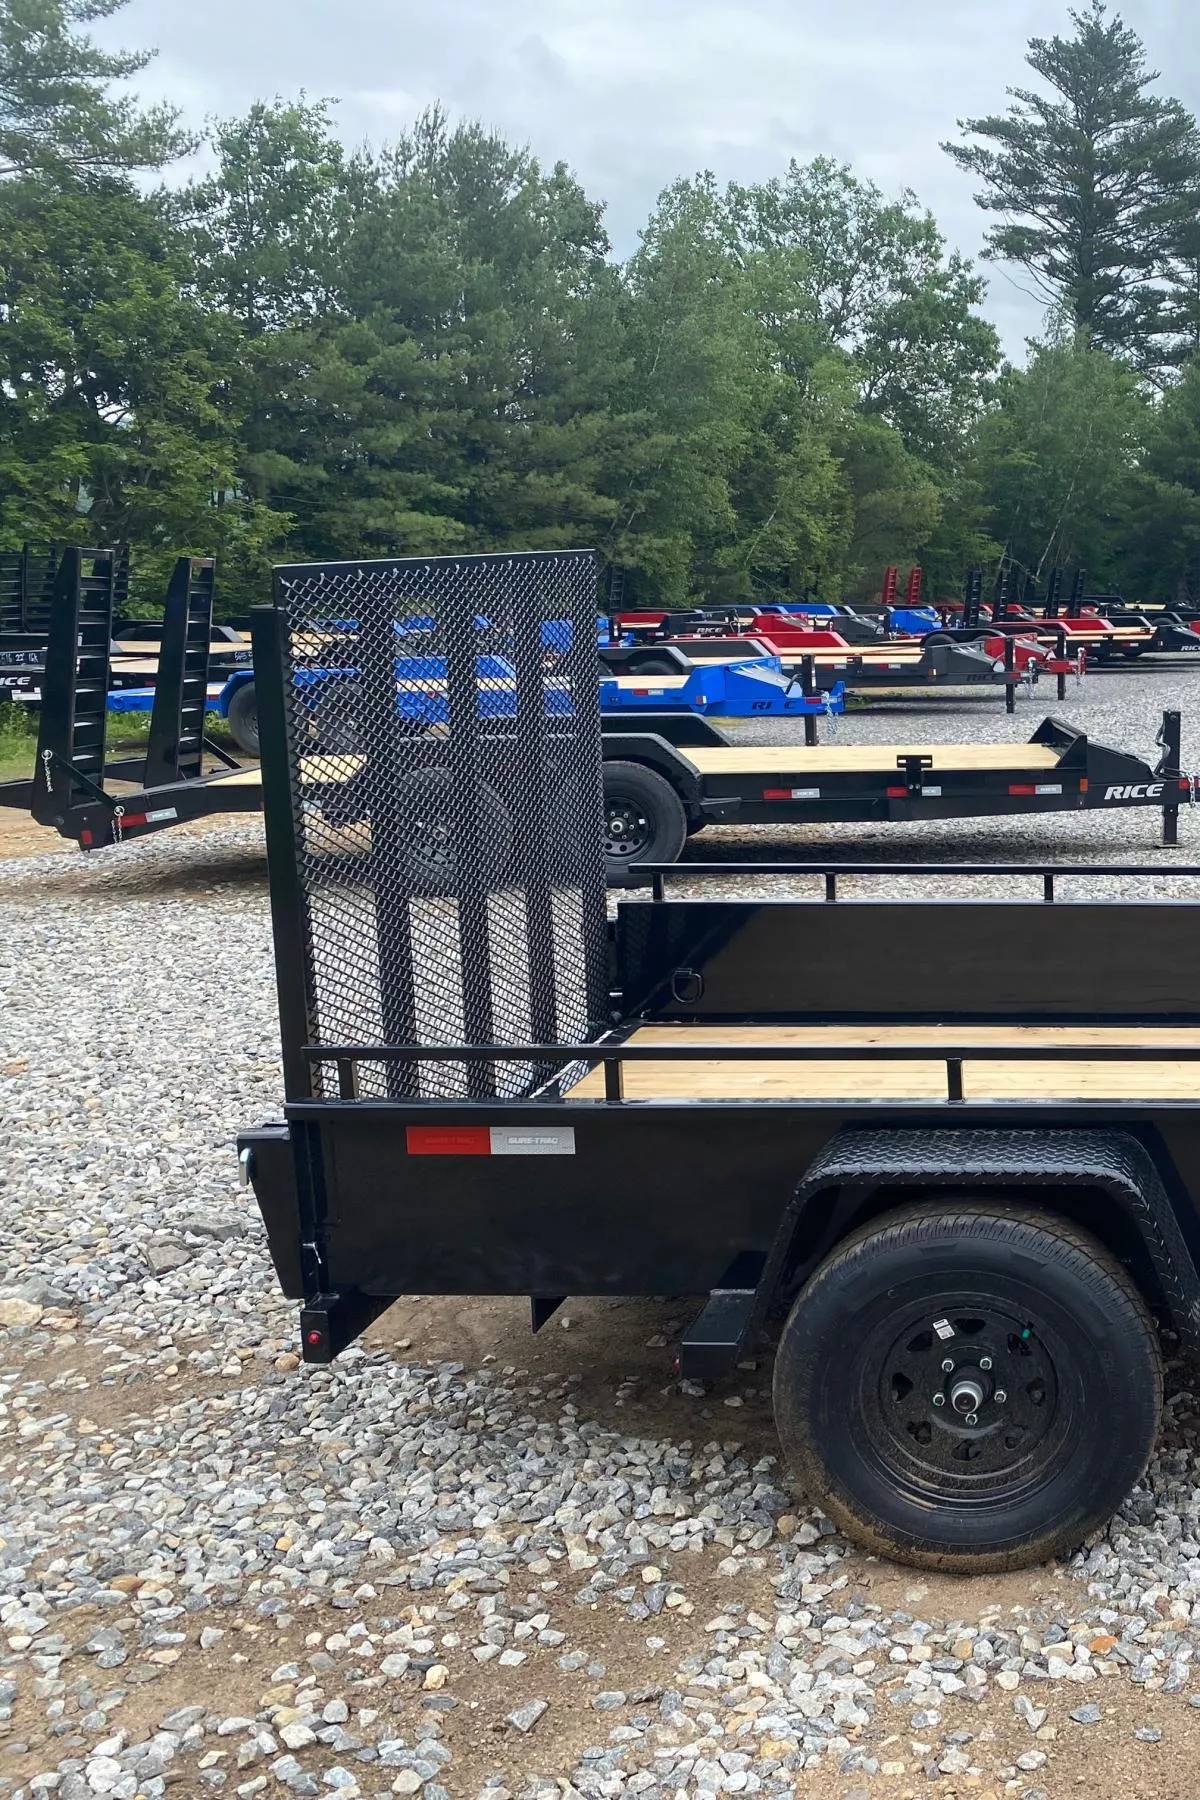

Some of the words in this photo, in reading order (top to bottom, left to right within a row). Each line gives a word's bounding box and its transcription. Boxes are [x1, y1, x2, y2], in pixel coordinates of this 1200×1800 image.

[0, 676, 31, 686] ICE
[1104, 783, 1165, 800] RICE
[507, 1136, 559, 1145] SURE-TRAC
